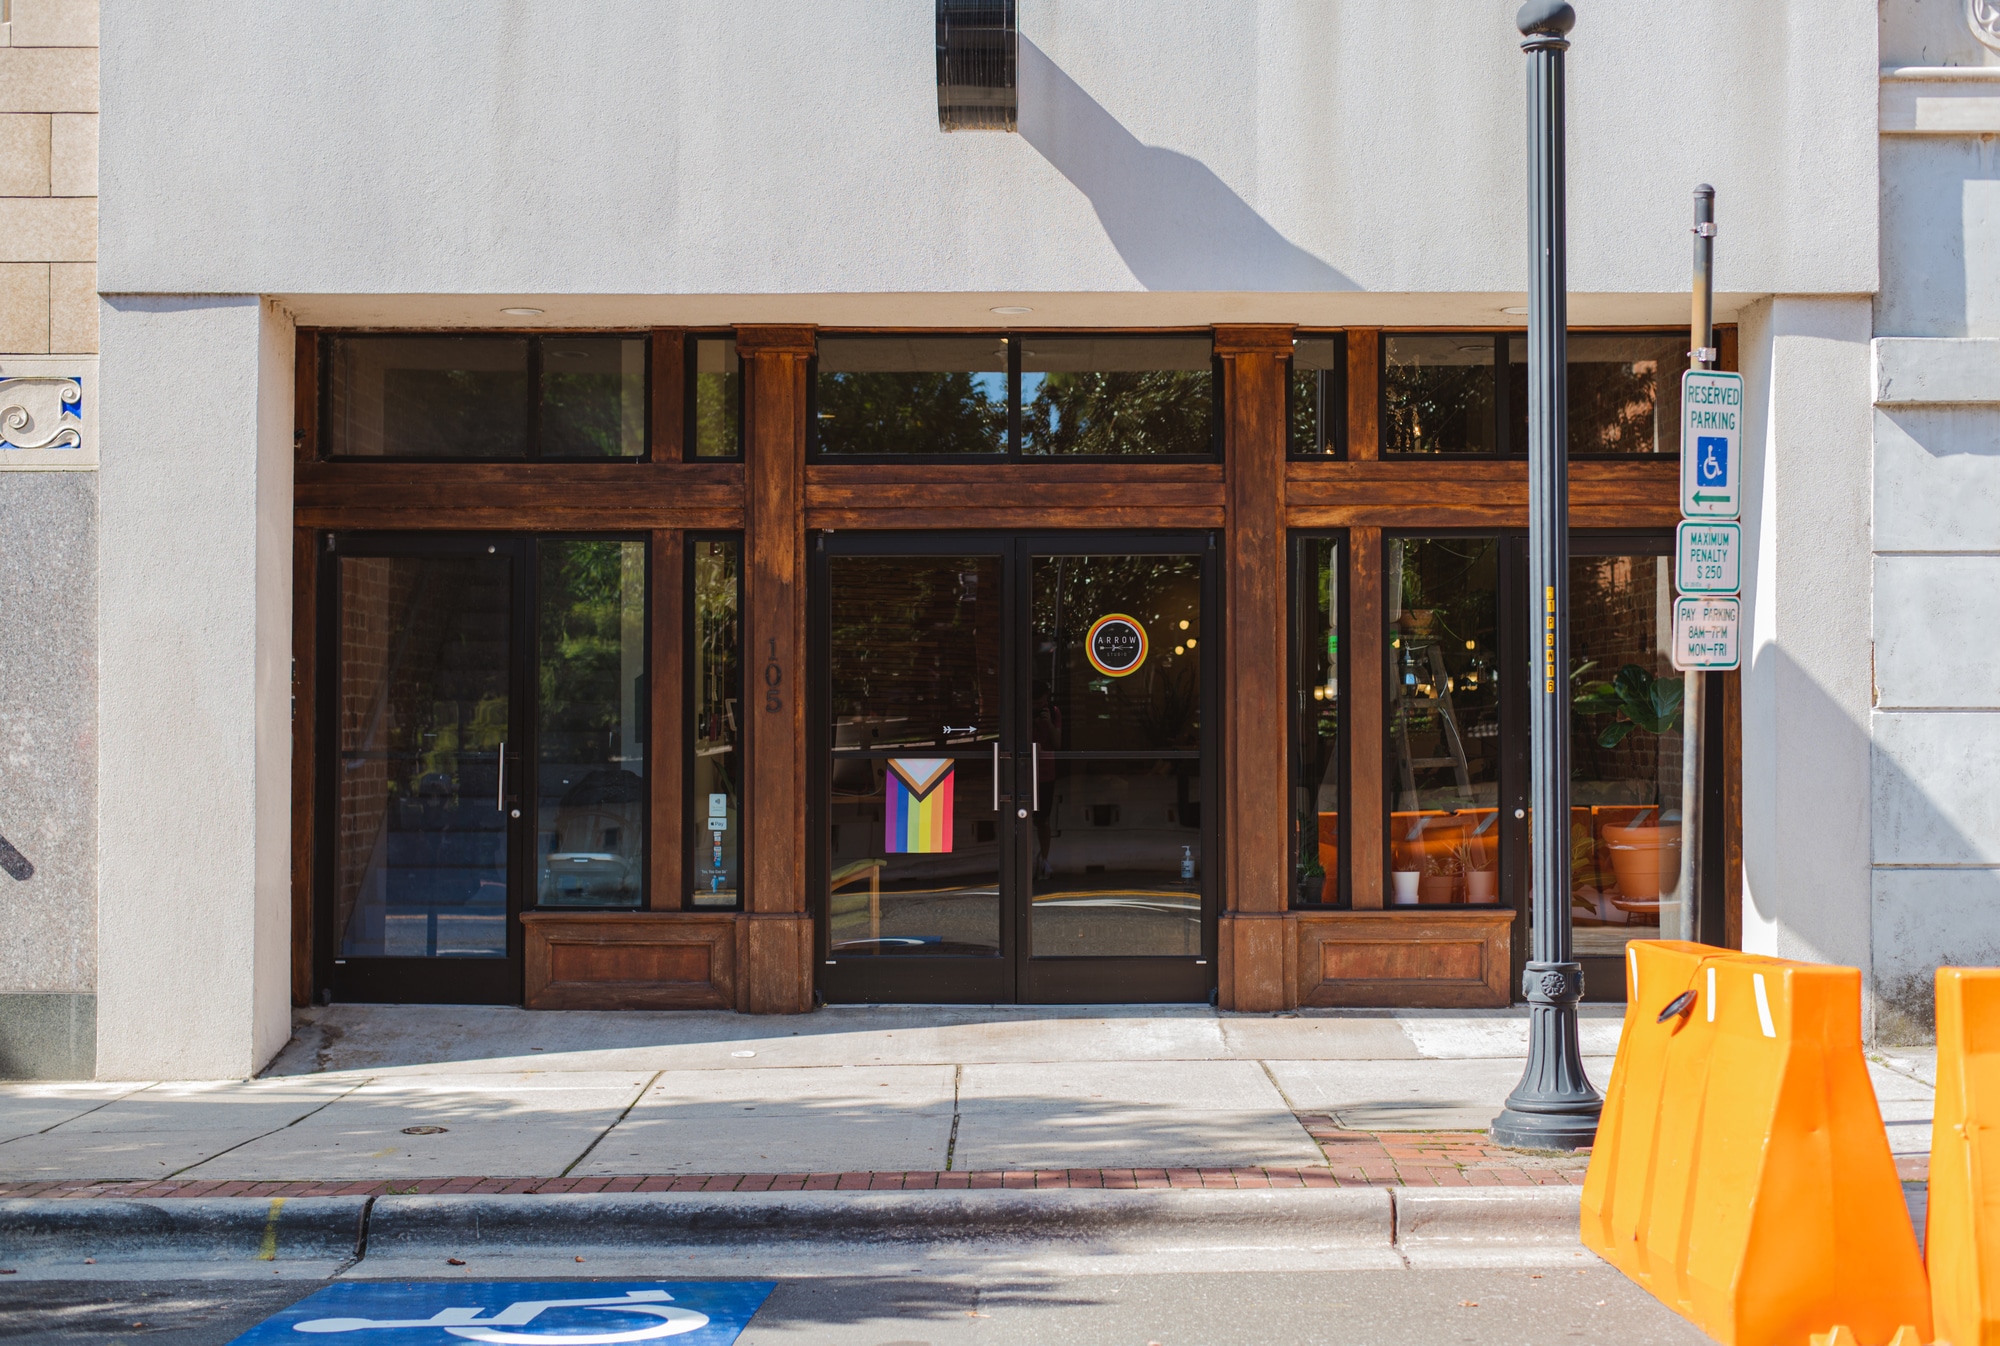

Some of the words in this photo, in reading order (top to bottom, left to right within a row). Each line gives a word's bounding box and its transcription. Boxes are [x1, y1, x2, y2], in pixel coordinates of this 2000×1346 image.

[1688, 385, 1740, 405] RESERVED
[1691, 410, 1736, 430] PARKING
[1690, 532, 1729, 546] MAXIMUM
[1690, 548, 1728, 562] PENALTY
[1705, 565, 1722, 579] 250
[1681, 608, 1696, 621] PAY
[1703, 608, 1736, 621] PARKING
[1098, 636, 1136, 644] ARROW
[1688, 643, 1727, 656] MON-FRI
[765, 637, 782, 713] 105
